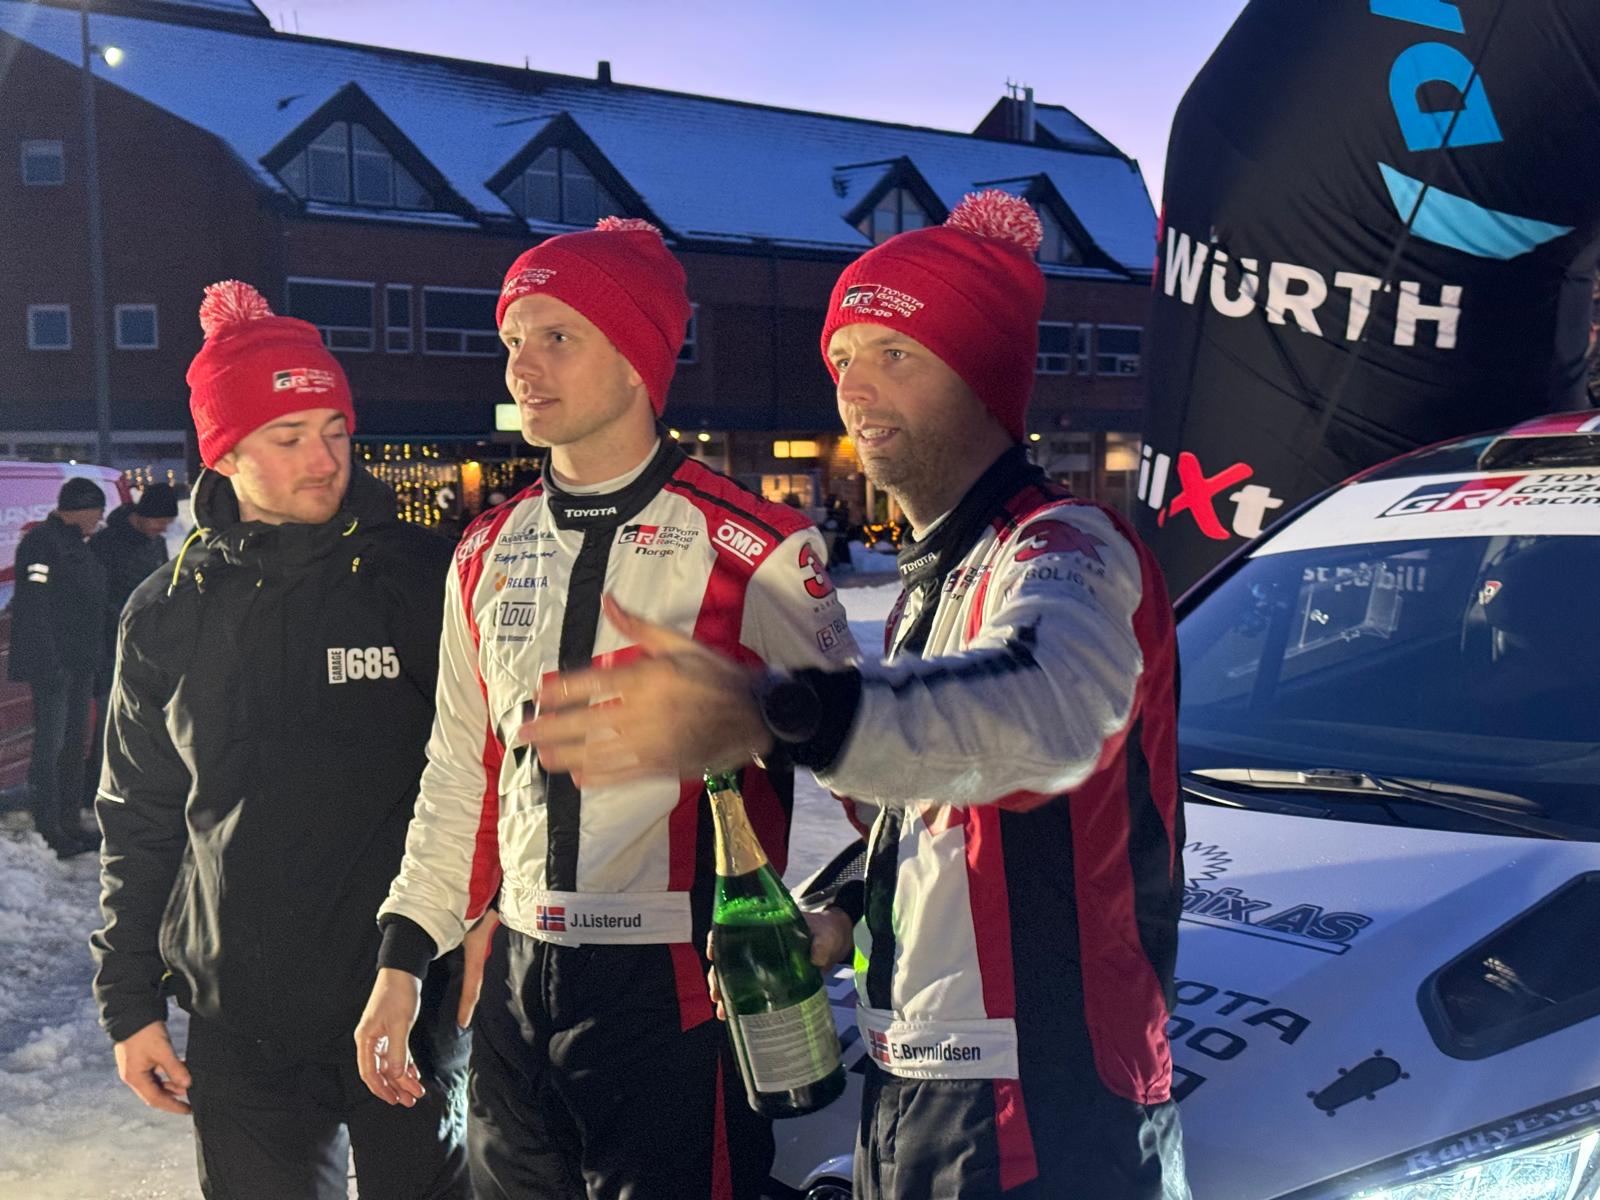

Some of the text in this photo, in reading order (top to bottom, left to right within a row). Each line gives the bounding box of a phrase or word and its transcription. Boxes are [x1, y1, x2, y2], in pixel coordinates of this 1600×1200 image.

[881, 286, 925, 309] TOYOTA
[1164, 226, 1463, 350] WÜRTH
[880, 301, 912, 318] acing
[1515, 484, 1600, 494] GAZ
[564, 506, 617, 518] TOYOTA
[1384, 487, 1504, 517] GR
[1498, 495, 1600, 507] Racin
[619, 531, 656, 546] GR
[659, 532, 693, 543] GAZOO
[662, 526, 699, 536] TOYOTA
[716, 524, 764, 559] OMP
[900, 552, 937, 575] TOYOTA
[506, 575, 548, 589] RELEKTA
[331, 650, 344, 682] GARAGE
[346, 646, 400, 680] 685
[570, 913, 642, 928] J.Listerud
[1254, 903, 1374, 943] AS
[1174, 977, 1311, 1045] OTA
[891, 1041, 981, 1063] E.Brynildsen
